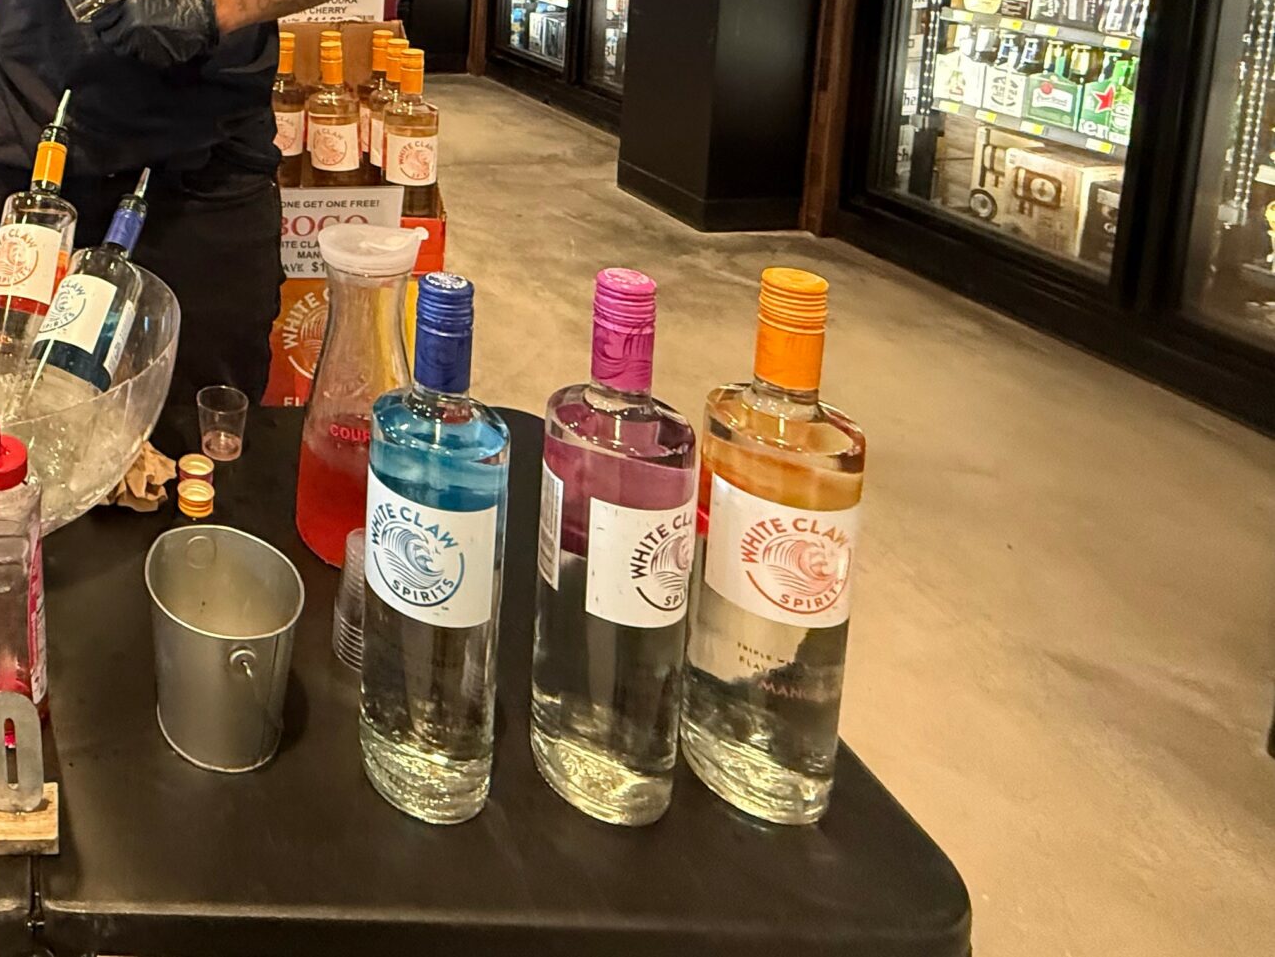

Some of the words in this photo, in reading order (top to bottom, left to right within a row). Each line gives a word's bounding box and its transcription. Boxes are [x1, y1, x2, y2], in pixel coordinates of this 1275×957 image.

[309, 6, 348, 15] CHERRY
[303, 201, 324, 209] GET
[326, 200, 347, 208] ONE
[350, 199, 381, 208] FREE!
[9, 227, 38, 248] CLAW
[282, 291, 320, 351] WHITE
[371, 503, 397, 546] WHITE
[399, 506, 459, 550] CLAW
[741, 517, 785, 564] WHITE
[791, 517, 849, 547] CLAW
[630, 523, 668, 579] WHITE
[392, 578, 455, 602] SPIRITS
[779, 578, 843, 609] SPIRITS
